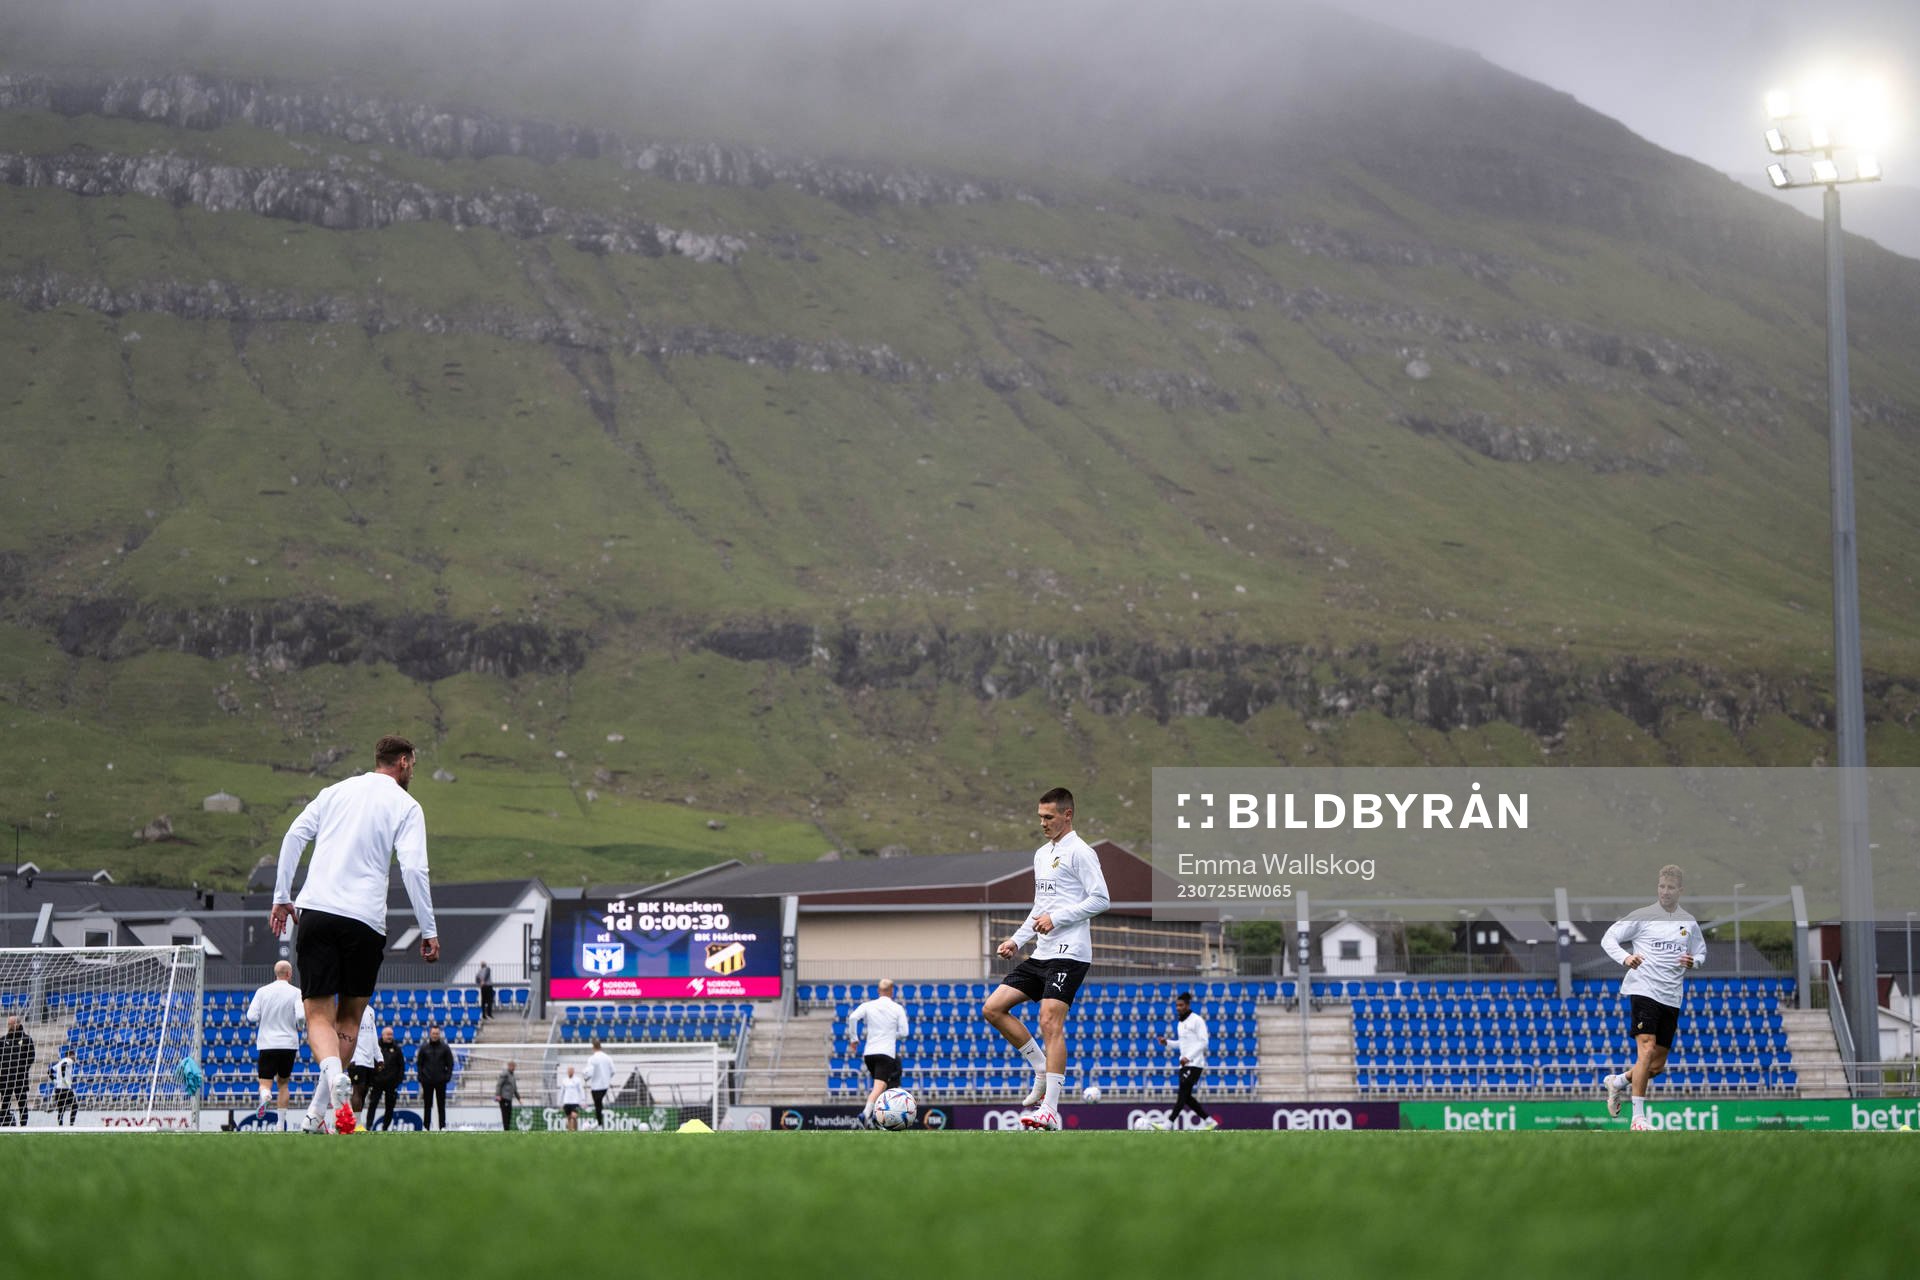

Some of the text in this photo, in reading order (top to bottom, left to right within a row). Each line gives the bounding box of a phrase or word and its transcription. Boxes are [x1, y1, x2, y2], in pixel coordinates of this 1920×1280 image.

[638, 902, 660, 913] BK
[602, 914, 730, 931] 1d 0:00:30
[1058, 944, 1069, 954] 17
[1057, 972, 1067, 983] 17
[1272, 1108, 1353, 1130] nema
[1444, 1105, 1516, 1131] betri
[1646, 1105, 1719, 1131] betri
